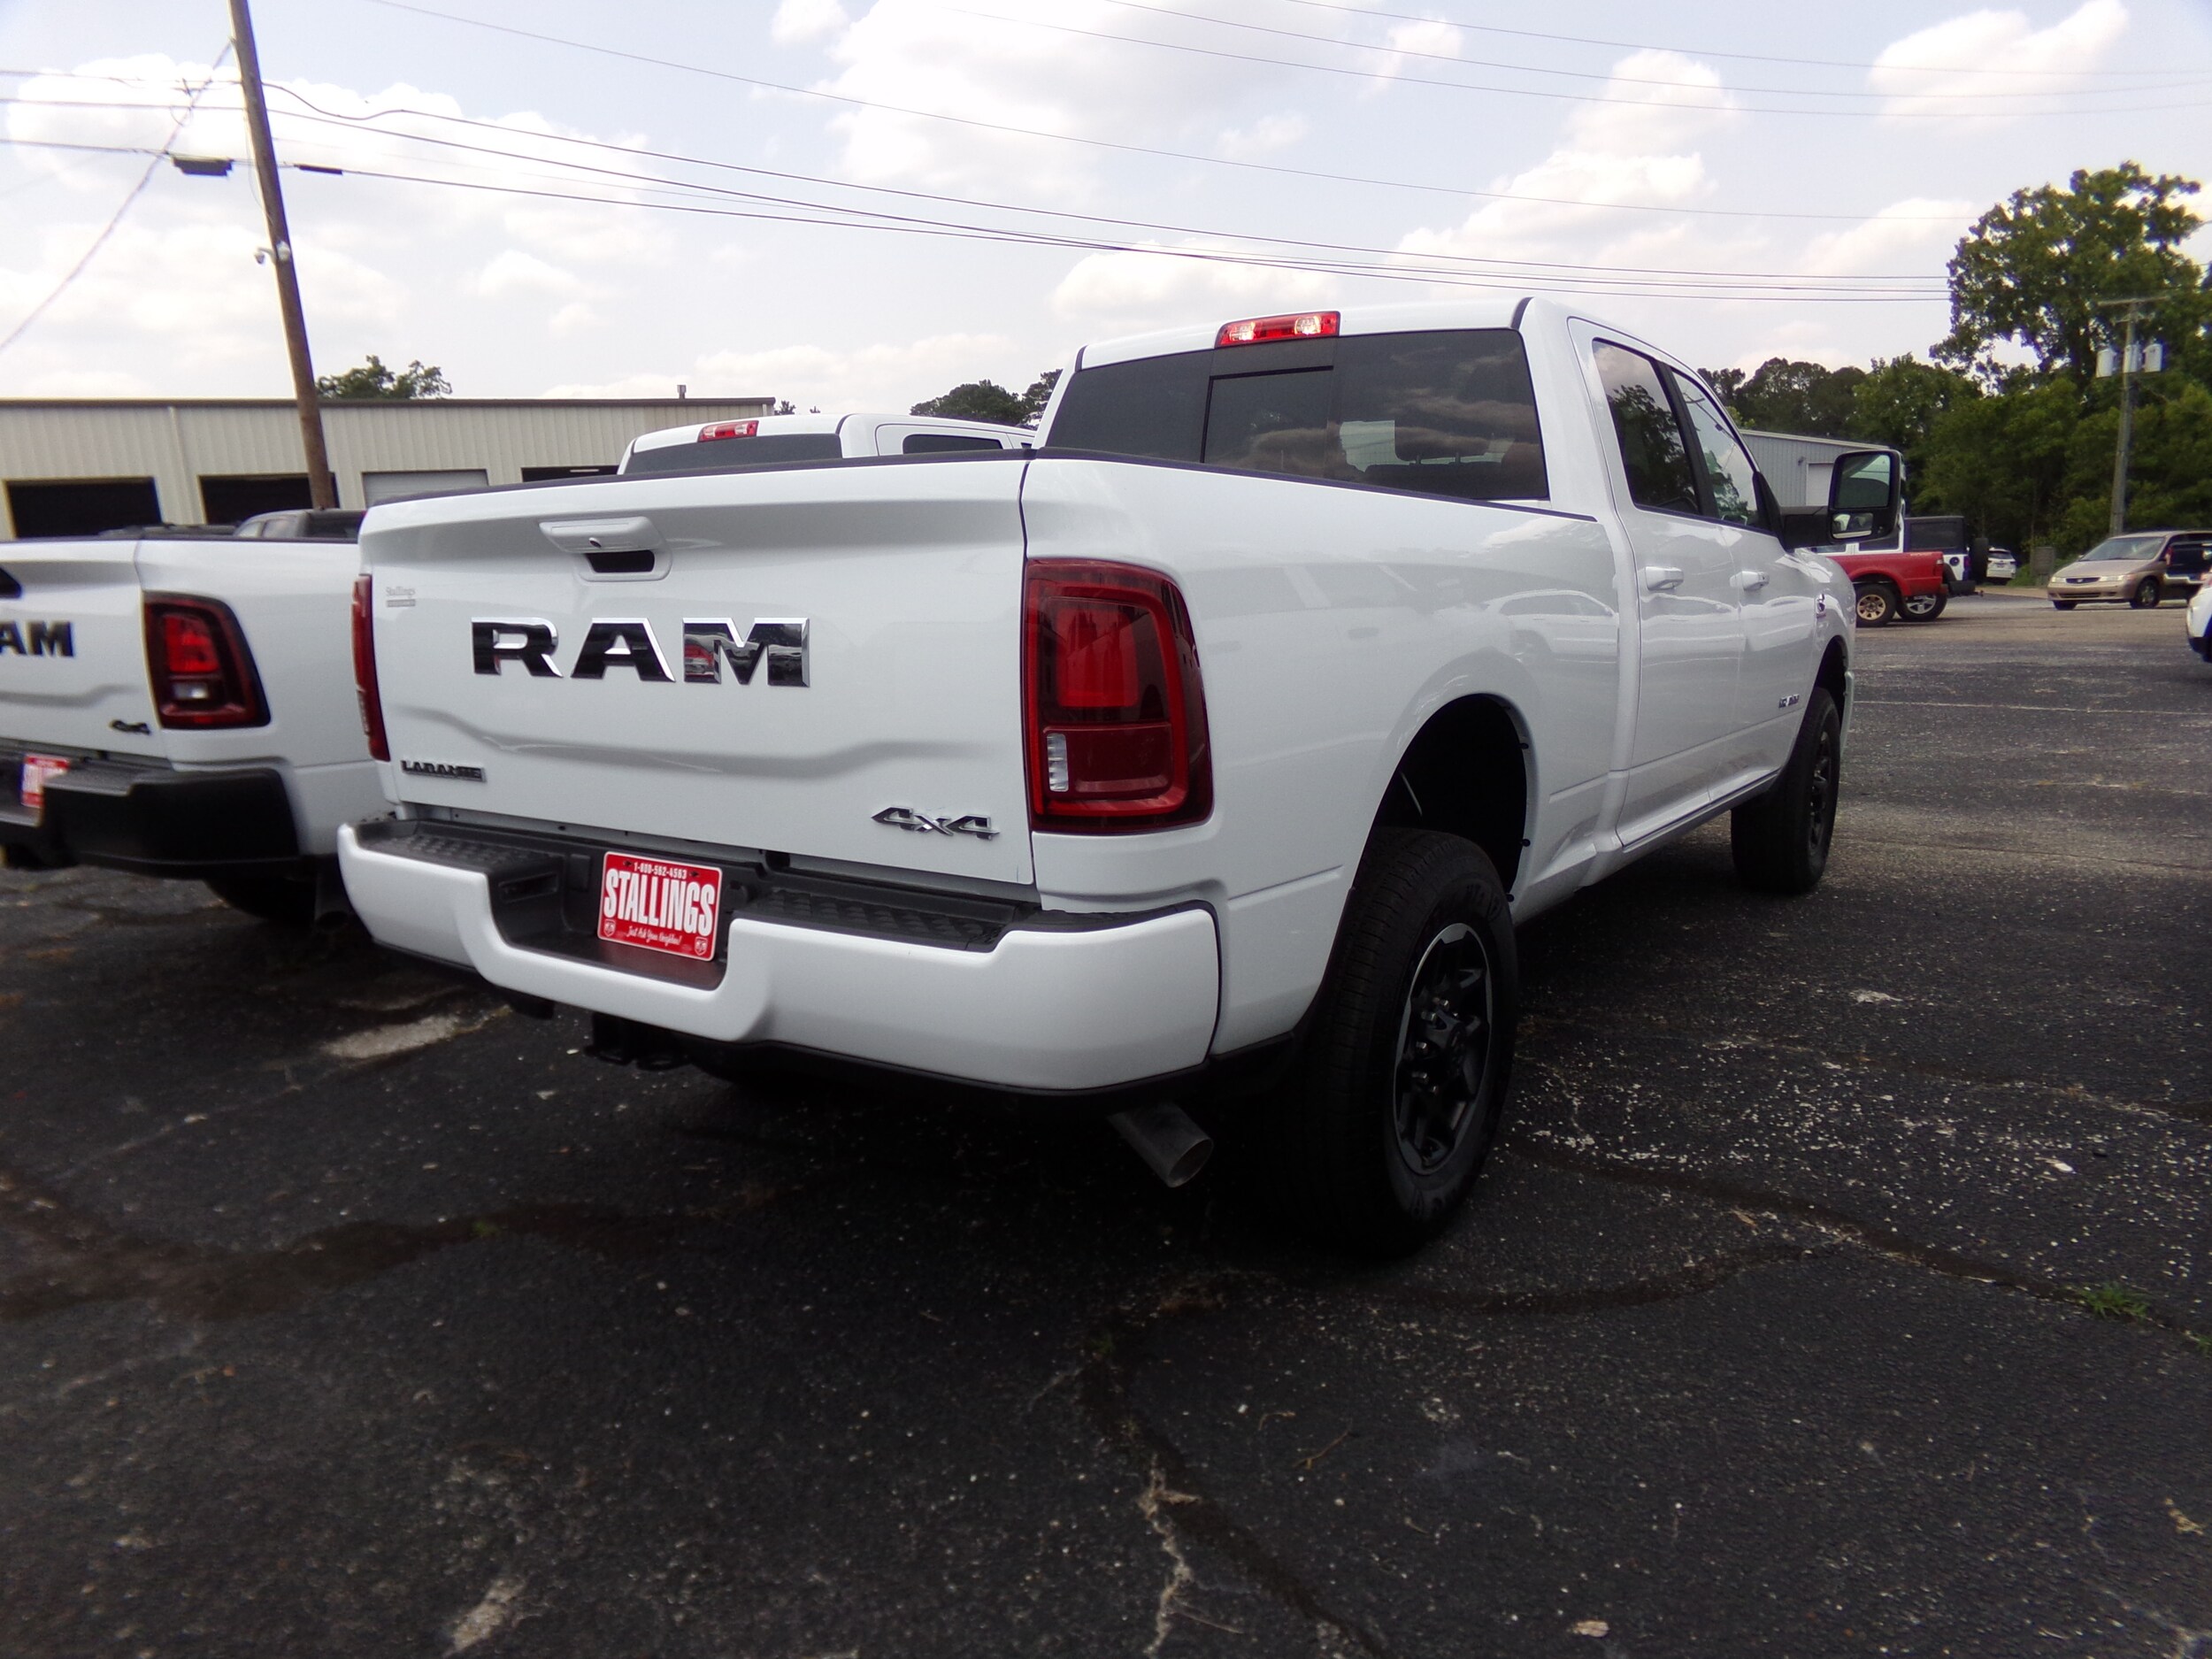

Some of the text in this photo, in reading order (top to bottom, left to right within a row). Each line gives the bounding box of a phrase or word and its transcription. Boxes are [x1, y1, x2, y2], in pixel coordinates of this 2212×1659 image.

[471, 617, 810, 687] RAM
[400, 759, 488, 783] LARAMIE
[871, 806, 1001, 841] 4x4
[603, 868, 716, 937] STALLINGS
